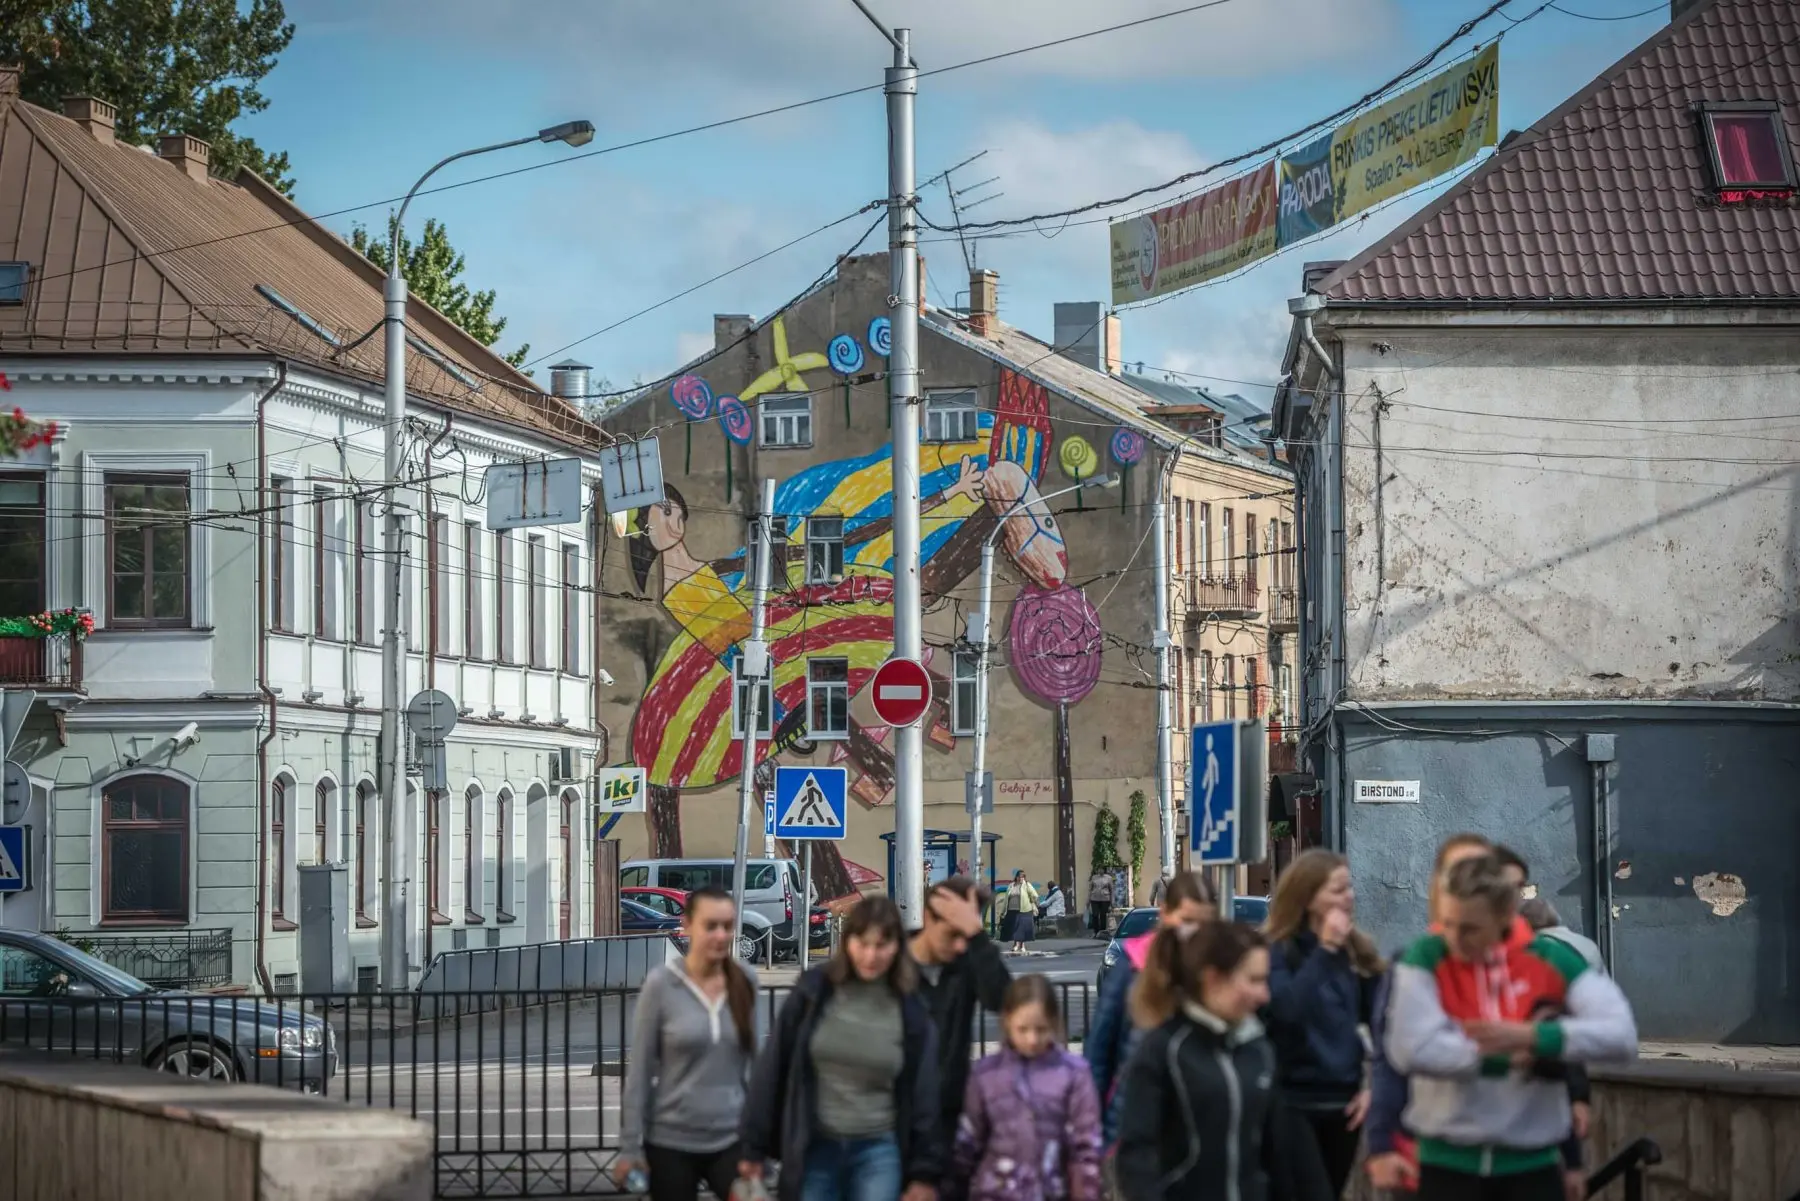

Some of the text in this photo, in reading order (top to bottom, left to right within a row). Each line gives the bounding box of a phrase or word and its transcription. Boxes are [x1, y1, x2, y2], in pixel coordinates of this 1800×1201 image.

[1335, 126, 1374, 173] RINKIS
[1281, 163, 1333, 219] PARODA
[1365, 163, 1393, 193] Spalio
[604, 774, 640, 800] iki
